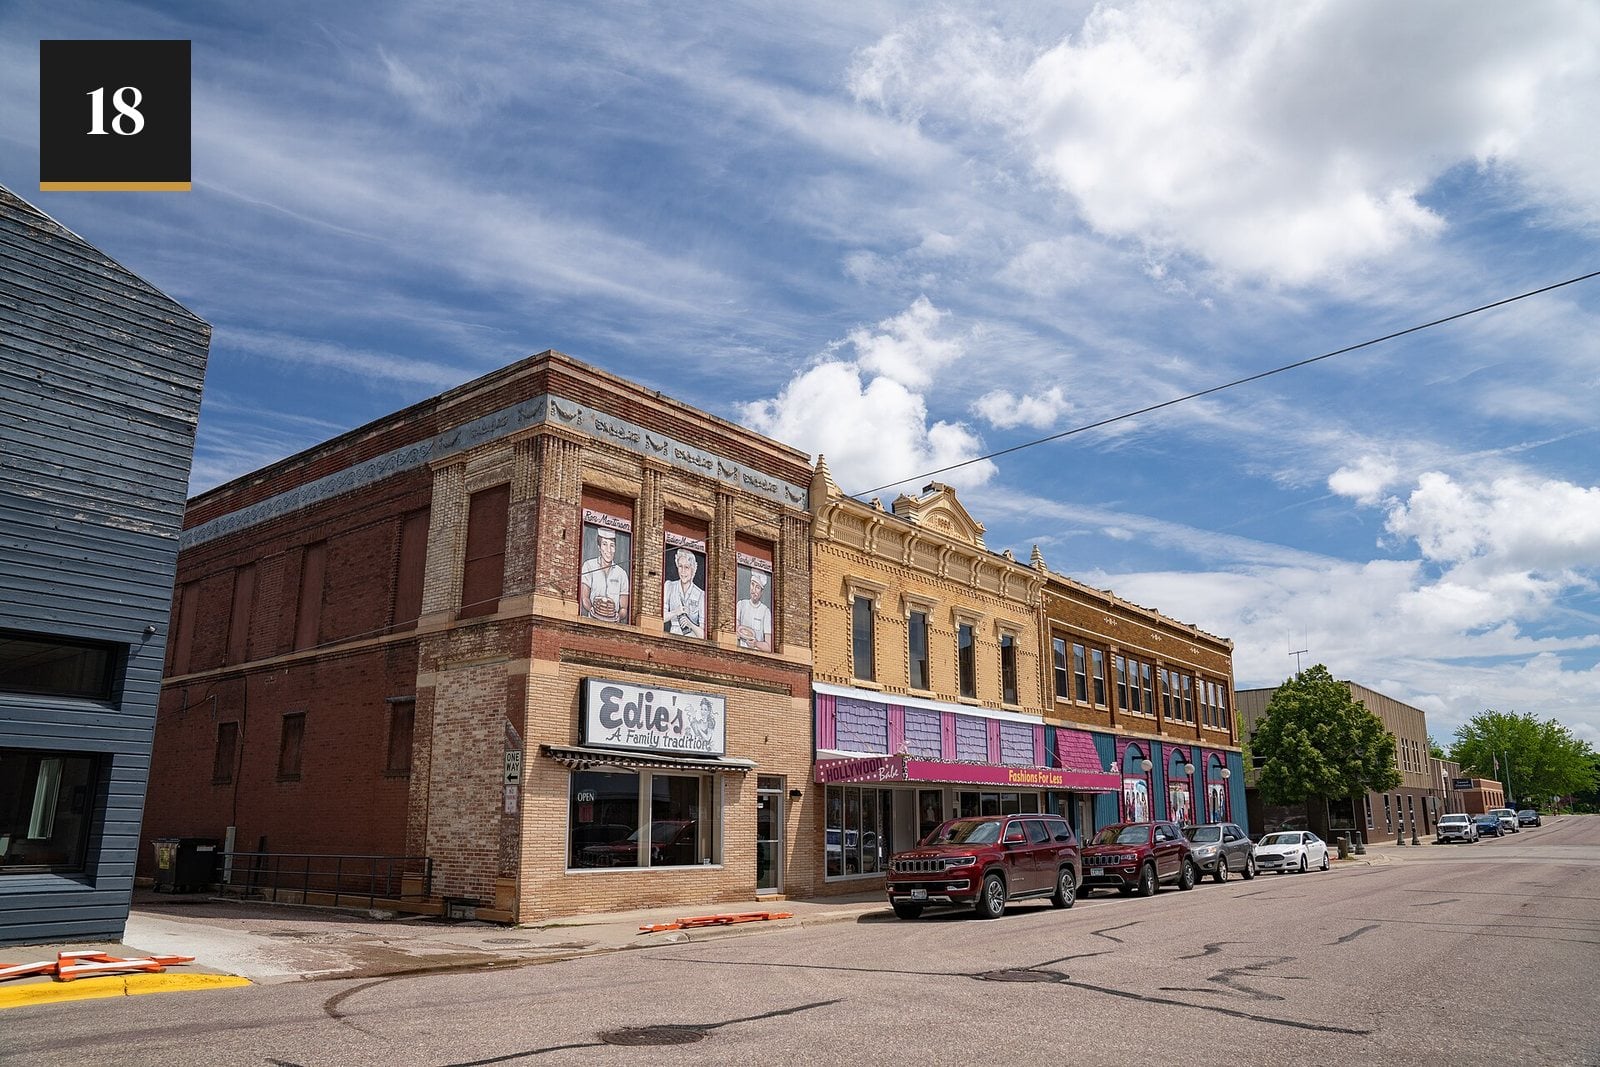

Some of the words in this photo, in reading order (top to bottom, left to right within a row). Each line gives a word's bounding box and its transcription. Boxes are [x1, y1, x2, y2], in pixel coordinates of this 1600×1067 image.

[599, 686, 683, 735] Edie's
[605, 727, 621, 742] A
[626, 729, 659, 748] Family
[506, 752, 520, 762] ONE
[506, 762, 520, 772] WAY
[826, 758, 883, 782] HOLLYWOOD
[1008, 769, 1037, 783] Fashions
[1038, 771, 1049, 784] For
[1049, 774, 1063, 785] Less
[577, 792, 595, 802] OPEN
